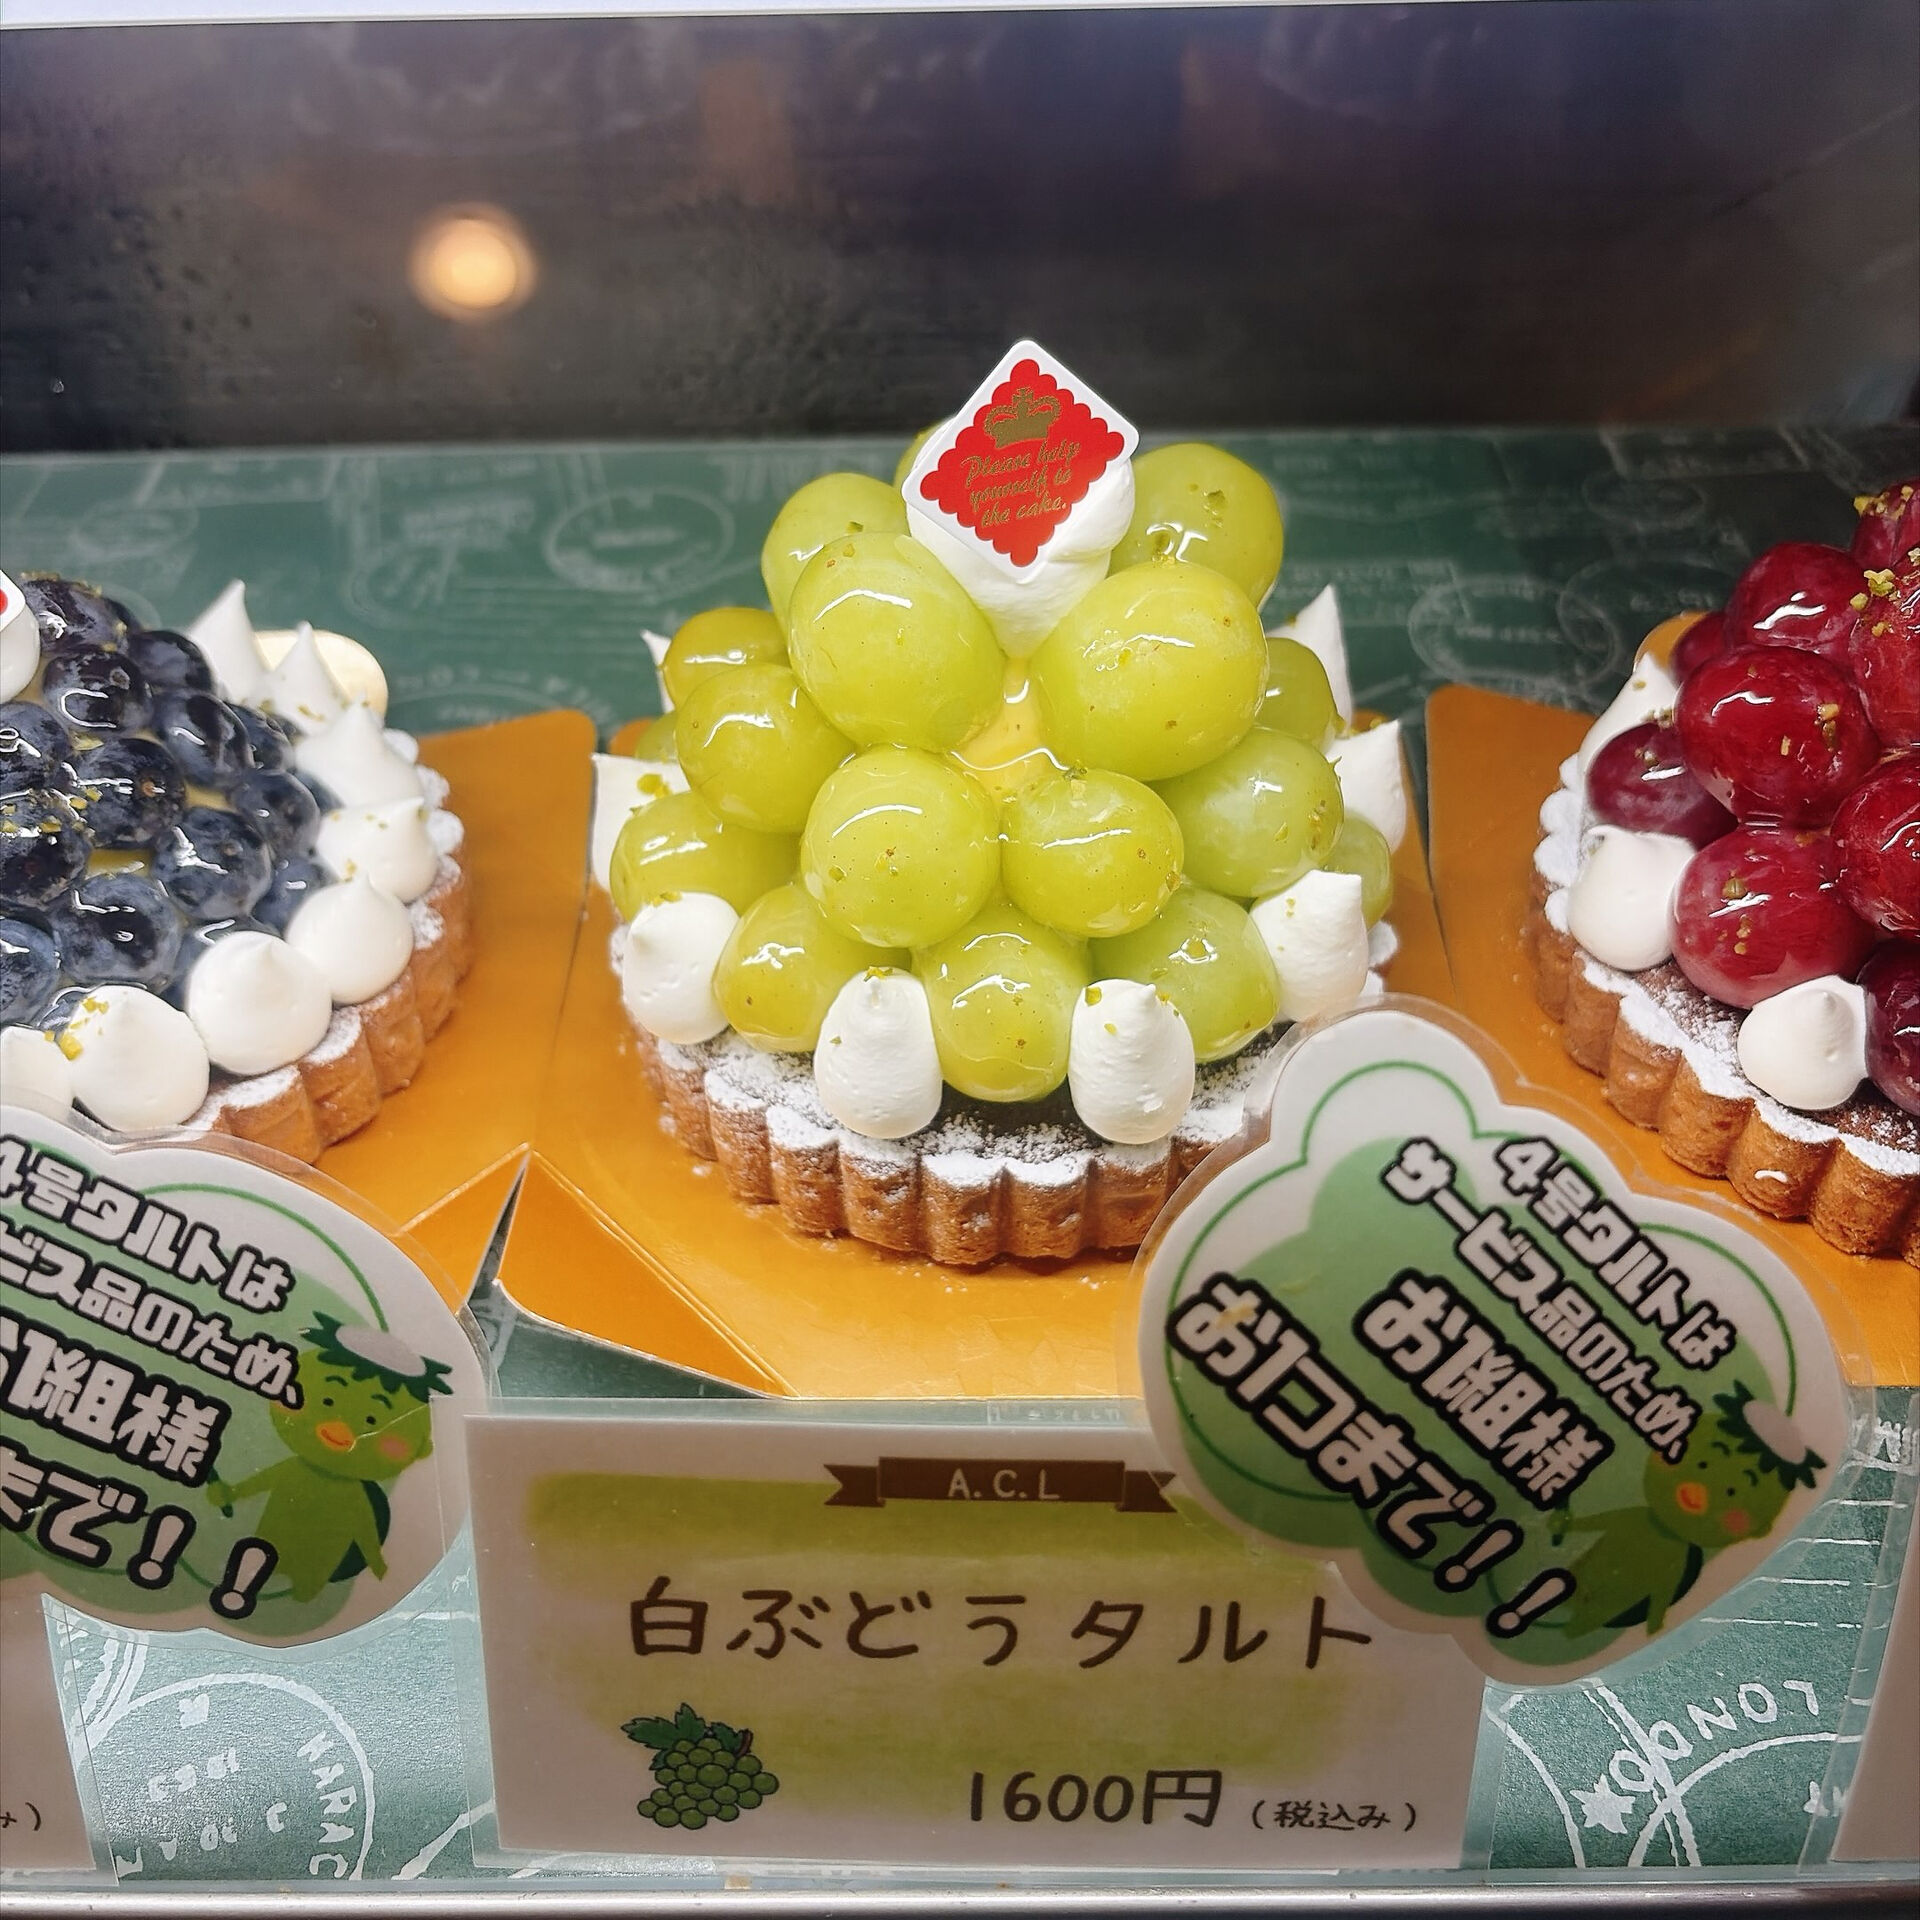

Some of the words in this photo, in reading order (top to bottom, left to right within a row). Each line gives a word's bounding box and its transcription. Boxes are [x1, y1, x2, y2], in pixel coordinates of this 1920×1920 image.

[961, 453, 1031, 488] Please
[1038, 438, 1080, 466] help
[970, 465, 1049, 512] yourself
[982, 501, 1011, 527] the
[1496, 1139, 1734, 1369] 4号タルトは
[1383, 1139, 1701, 1462] サービス品のため、
[0, 1315, 229, 1485] 1組様
[1356, 1271, 1610, 1504] お1組様
[947, 1468, 1061, 1500] A.C.L
[630, 1575, 1373, 1669] 白ぶどうタルト
[970, 1769, 1223, 1828] 1600円
[1252, 1800, 1417, 1832] (税込み)
